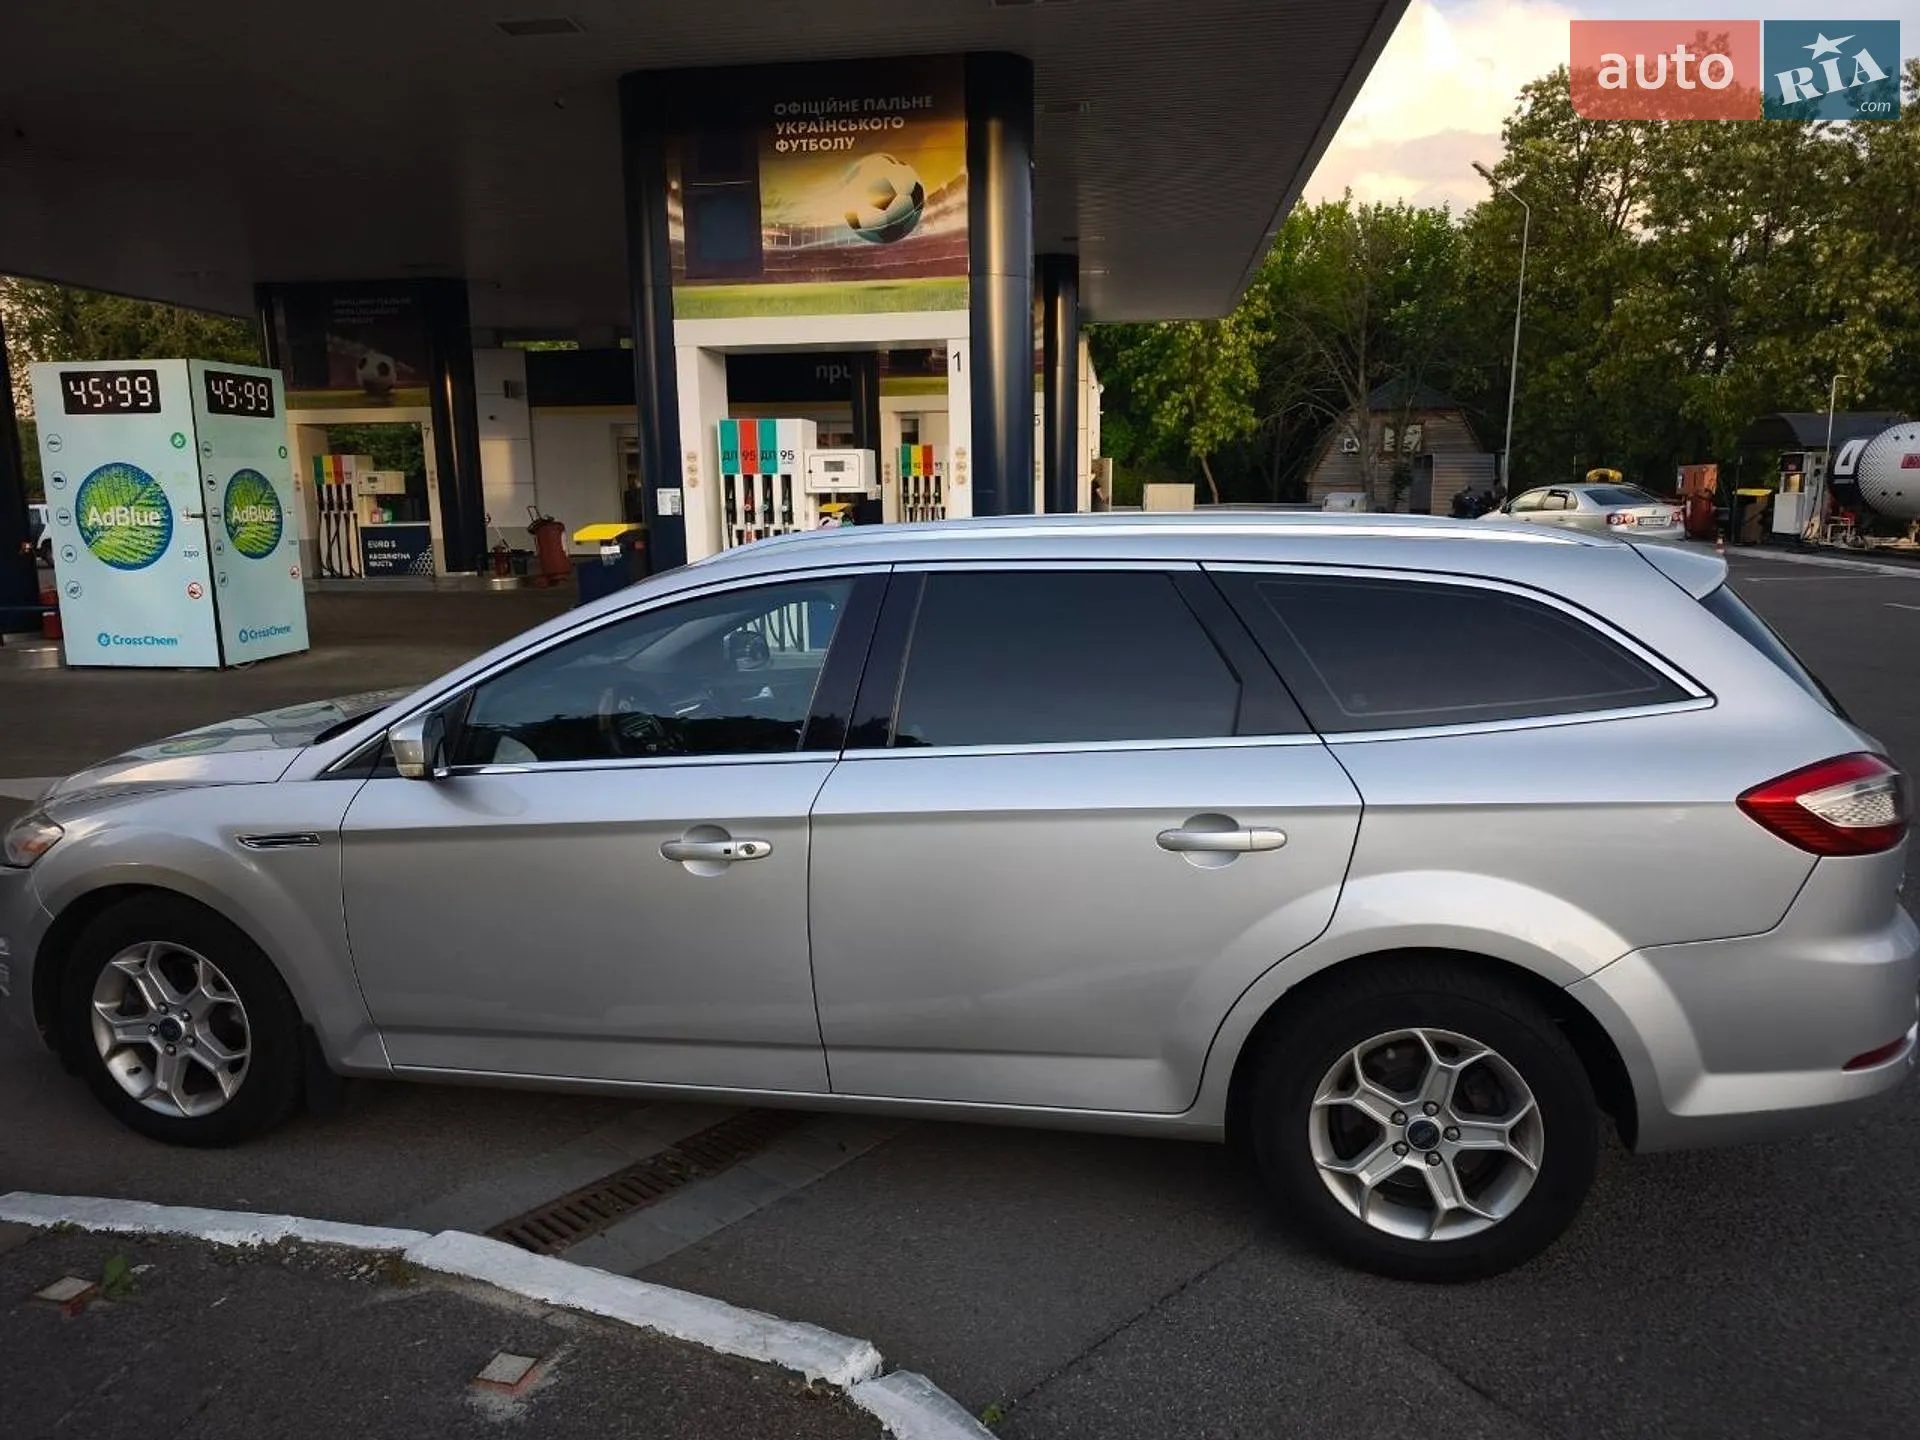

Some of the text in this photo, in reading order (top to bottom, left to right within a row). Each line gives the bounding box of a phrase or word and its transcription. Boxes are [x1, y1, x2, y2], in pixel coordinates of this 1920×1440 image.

[774, 95, 933, 117] ОФІЦІЙНЕ ПАЛЬНЕ
[775, 115, 905, 136] УКРАЇНСЬКОГО
[775, 137, 856, 154] ФУТБОЛУ
[952, 351, 962, 373] 1
[780, 450, 795, 460] 95
[88, 505, 161, 527] AdBlue
[233, 505, 276, 522] AdBlue
[112, 635, 178, 646] CrossChem
